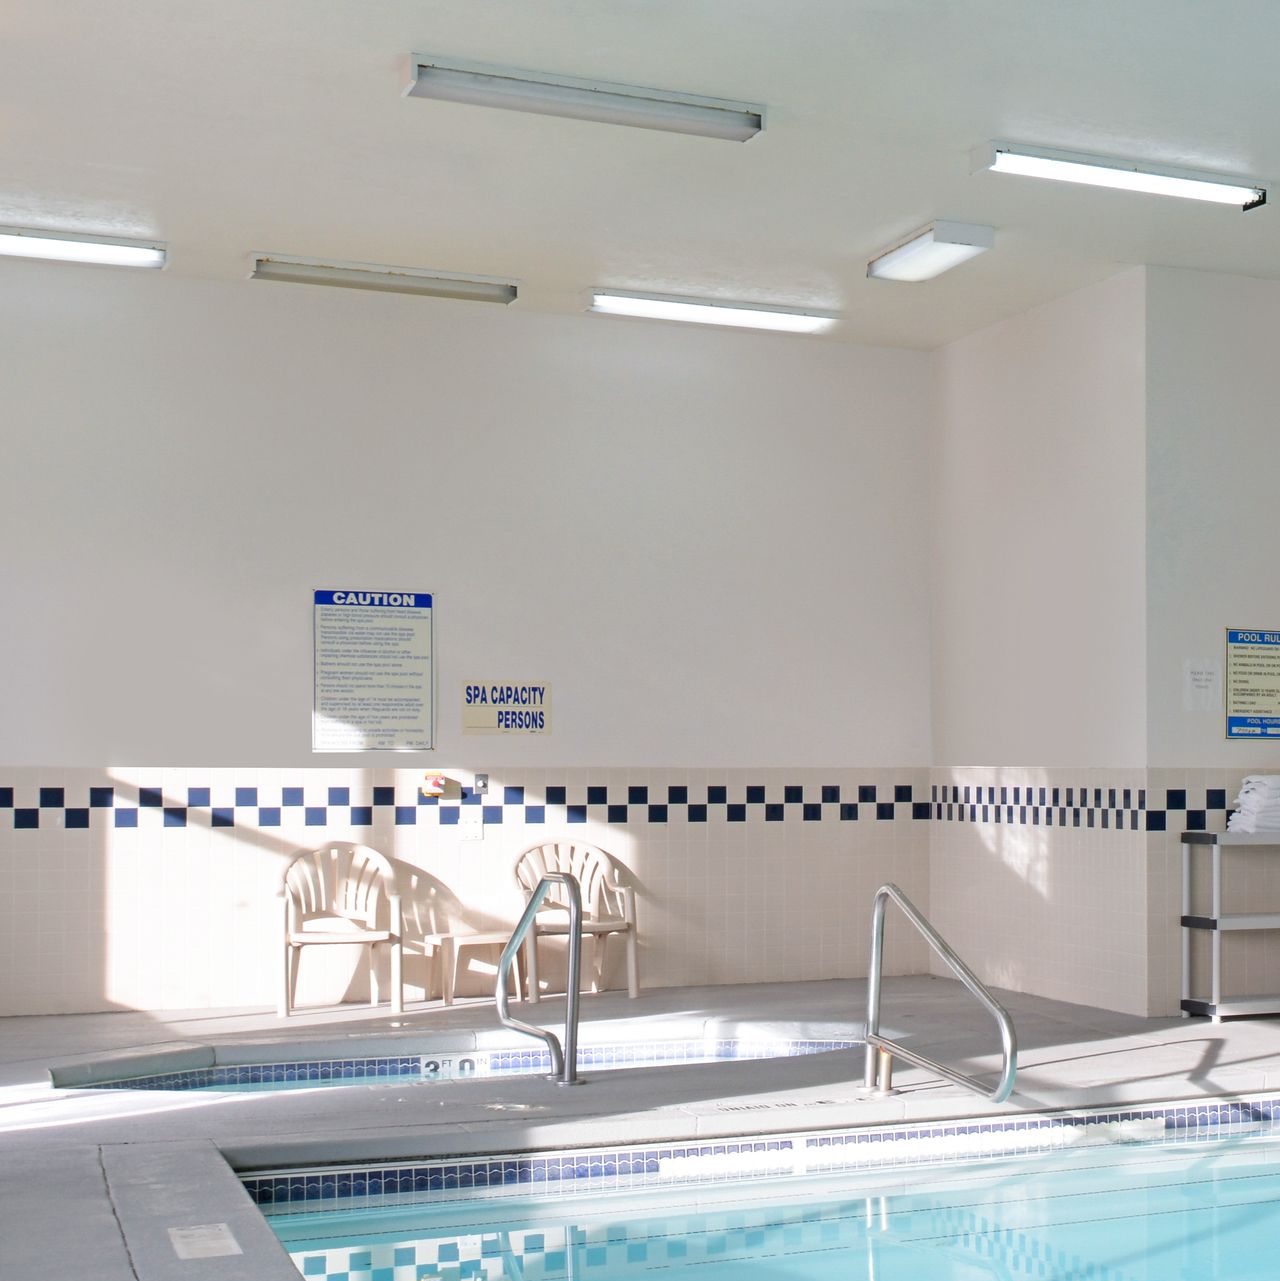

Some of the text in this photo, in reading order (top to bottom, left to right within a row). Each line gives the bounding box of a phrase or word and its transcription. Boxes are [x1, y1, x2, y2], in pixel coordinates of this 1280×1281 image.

[332, 591, 416, 607] CAUTION
[1238, 633, 1262, 642] POOL
[465, 685, 545, 704] SPA CAPACITY
[497, 710, 545, 729] PERSONS
[442, 1059, 453, 1068] FT
